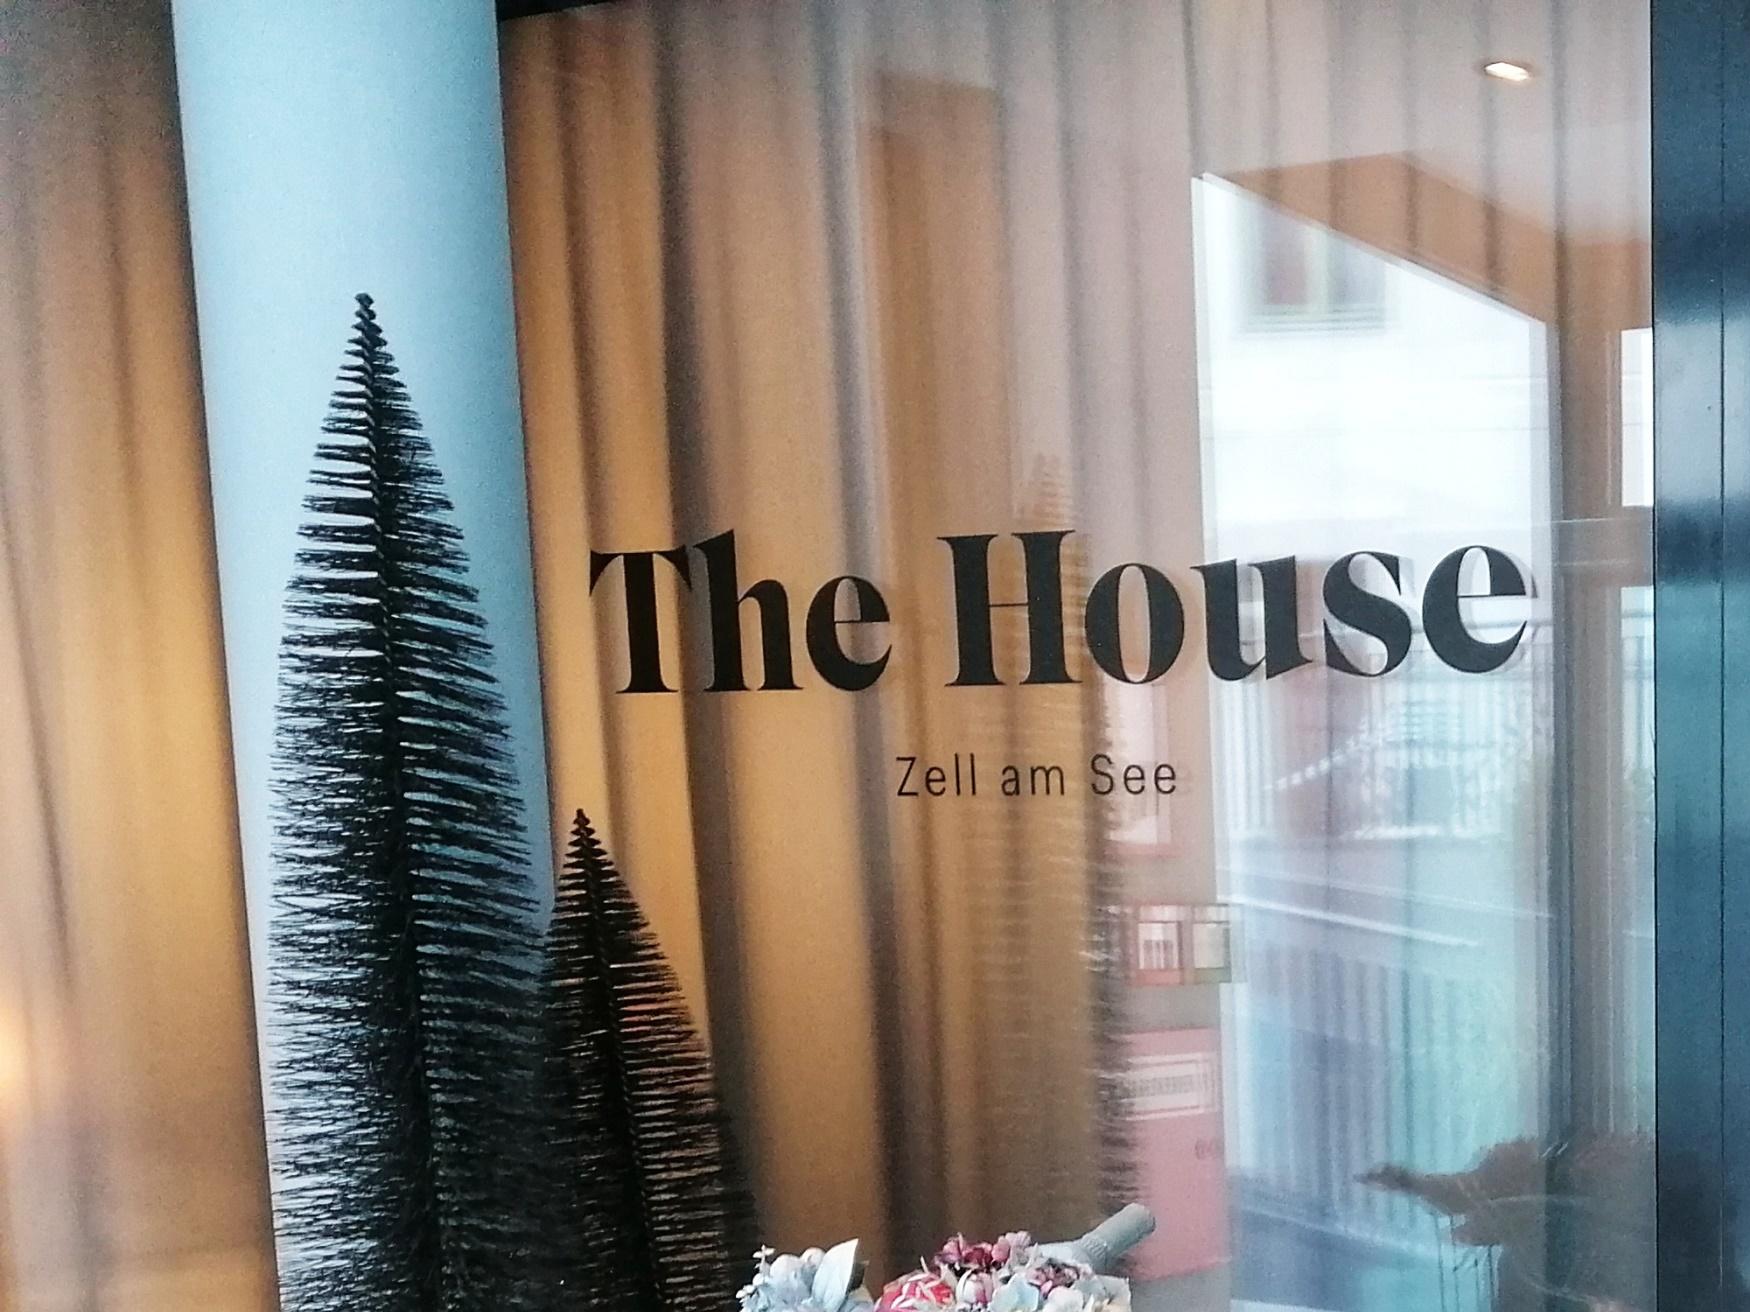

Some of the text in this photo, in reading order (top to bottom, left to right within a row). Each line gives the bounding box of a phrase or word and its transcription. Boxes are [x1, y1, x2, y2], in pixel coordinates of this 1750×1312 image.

[589, 529, 1529, 694] The House
[895, 752, 1177, 798] Zell am See
